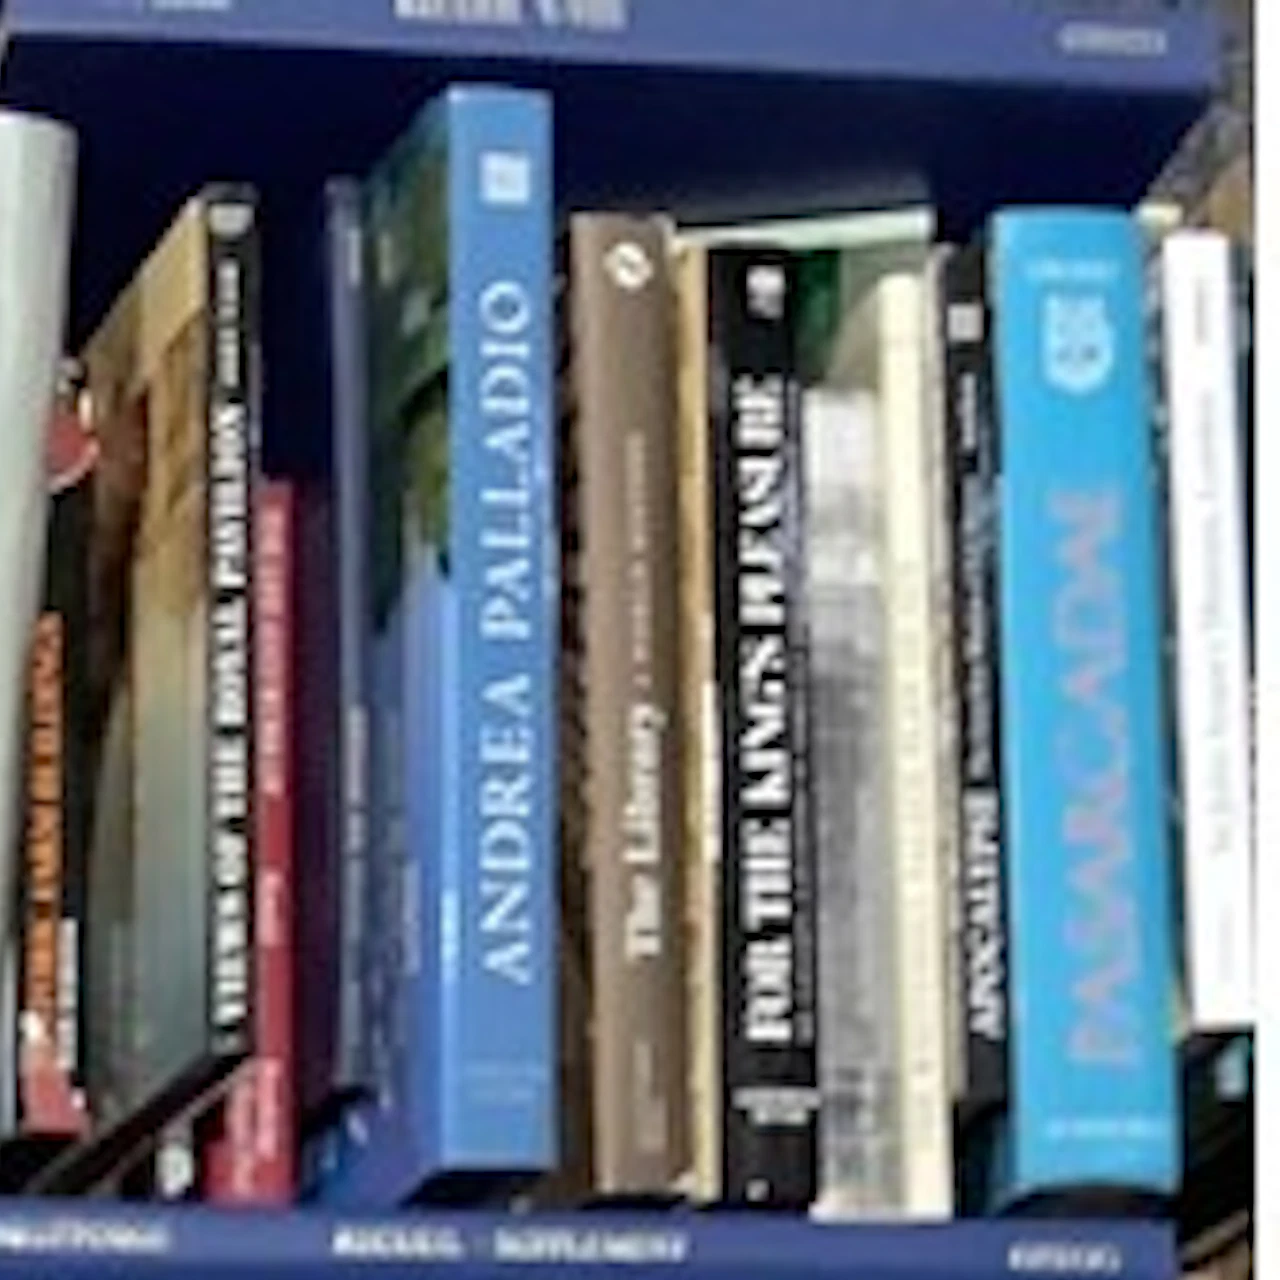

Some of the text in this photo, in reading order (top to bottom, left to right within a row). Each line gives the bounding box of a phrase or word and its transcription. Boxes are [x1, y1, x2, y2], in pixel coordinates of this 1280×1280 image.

[733, 375, 787, 623] PLEASURE
[211, 400, 249, 1026] VIEWS OF THE ROYAL PAVILION
[481, 278, 535, 985] ANDREA PALLADIO
[624, 701, 667, 963] The Library
[741, 816, 791, 924] THE
[744, 931, 793, 1043] FOR
